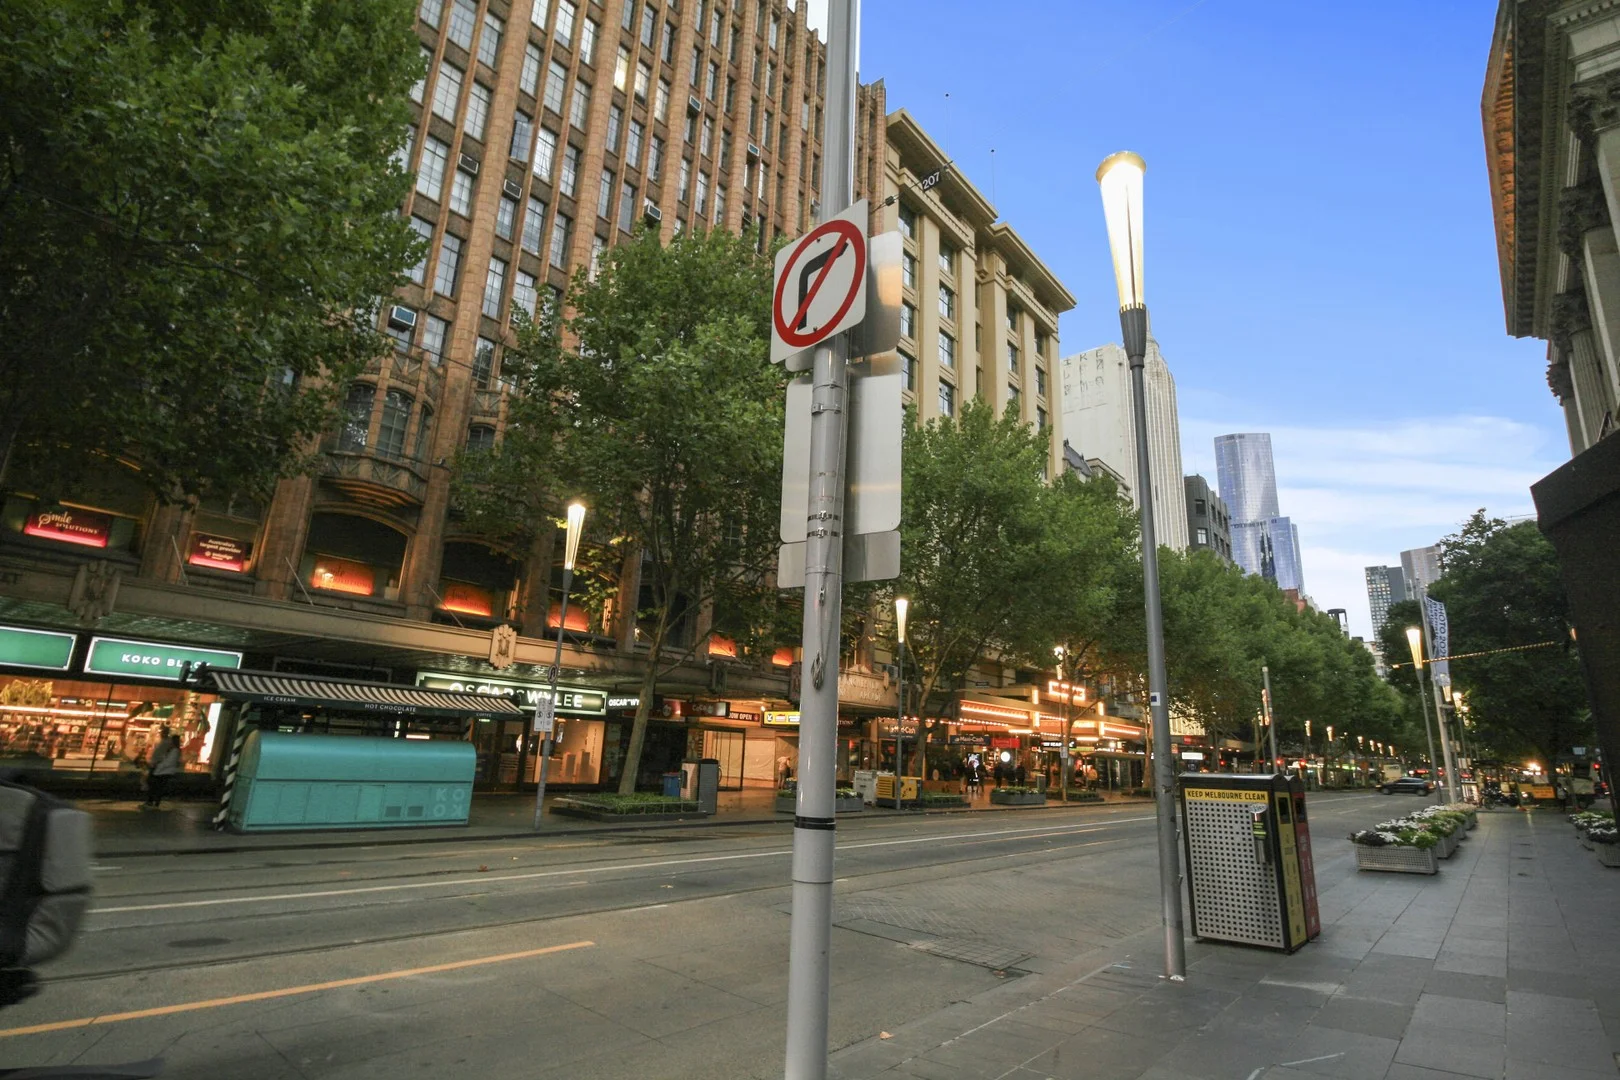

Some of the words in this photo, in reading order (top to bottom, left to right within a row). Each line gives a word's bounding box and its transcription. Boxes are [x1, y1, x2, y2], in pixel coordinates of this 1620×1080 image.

[922, 171, 940, 190] 207
[38, 511, 73, 528] Smile
[55, 522, 99, 535] SOLUTIONS
[121, 653, 161, 666] KOKO
[166, 658, 212, 670] BLC
[608, 698, 628, 706] OSCAR
[379, 704, 417, 713] CHOCOLATE
[739, 713, 753, 721] OPEN
[1187, 790, 1204, 798] KEEP
[1204, 791, 1243, 800] MELBOURNE
[1244, 793, 1266, 801] CLEAN
